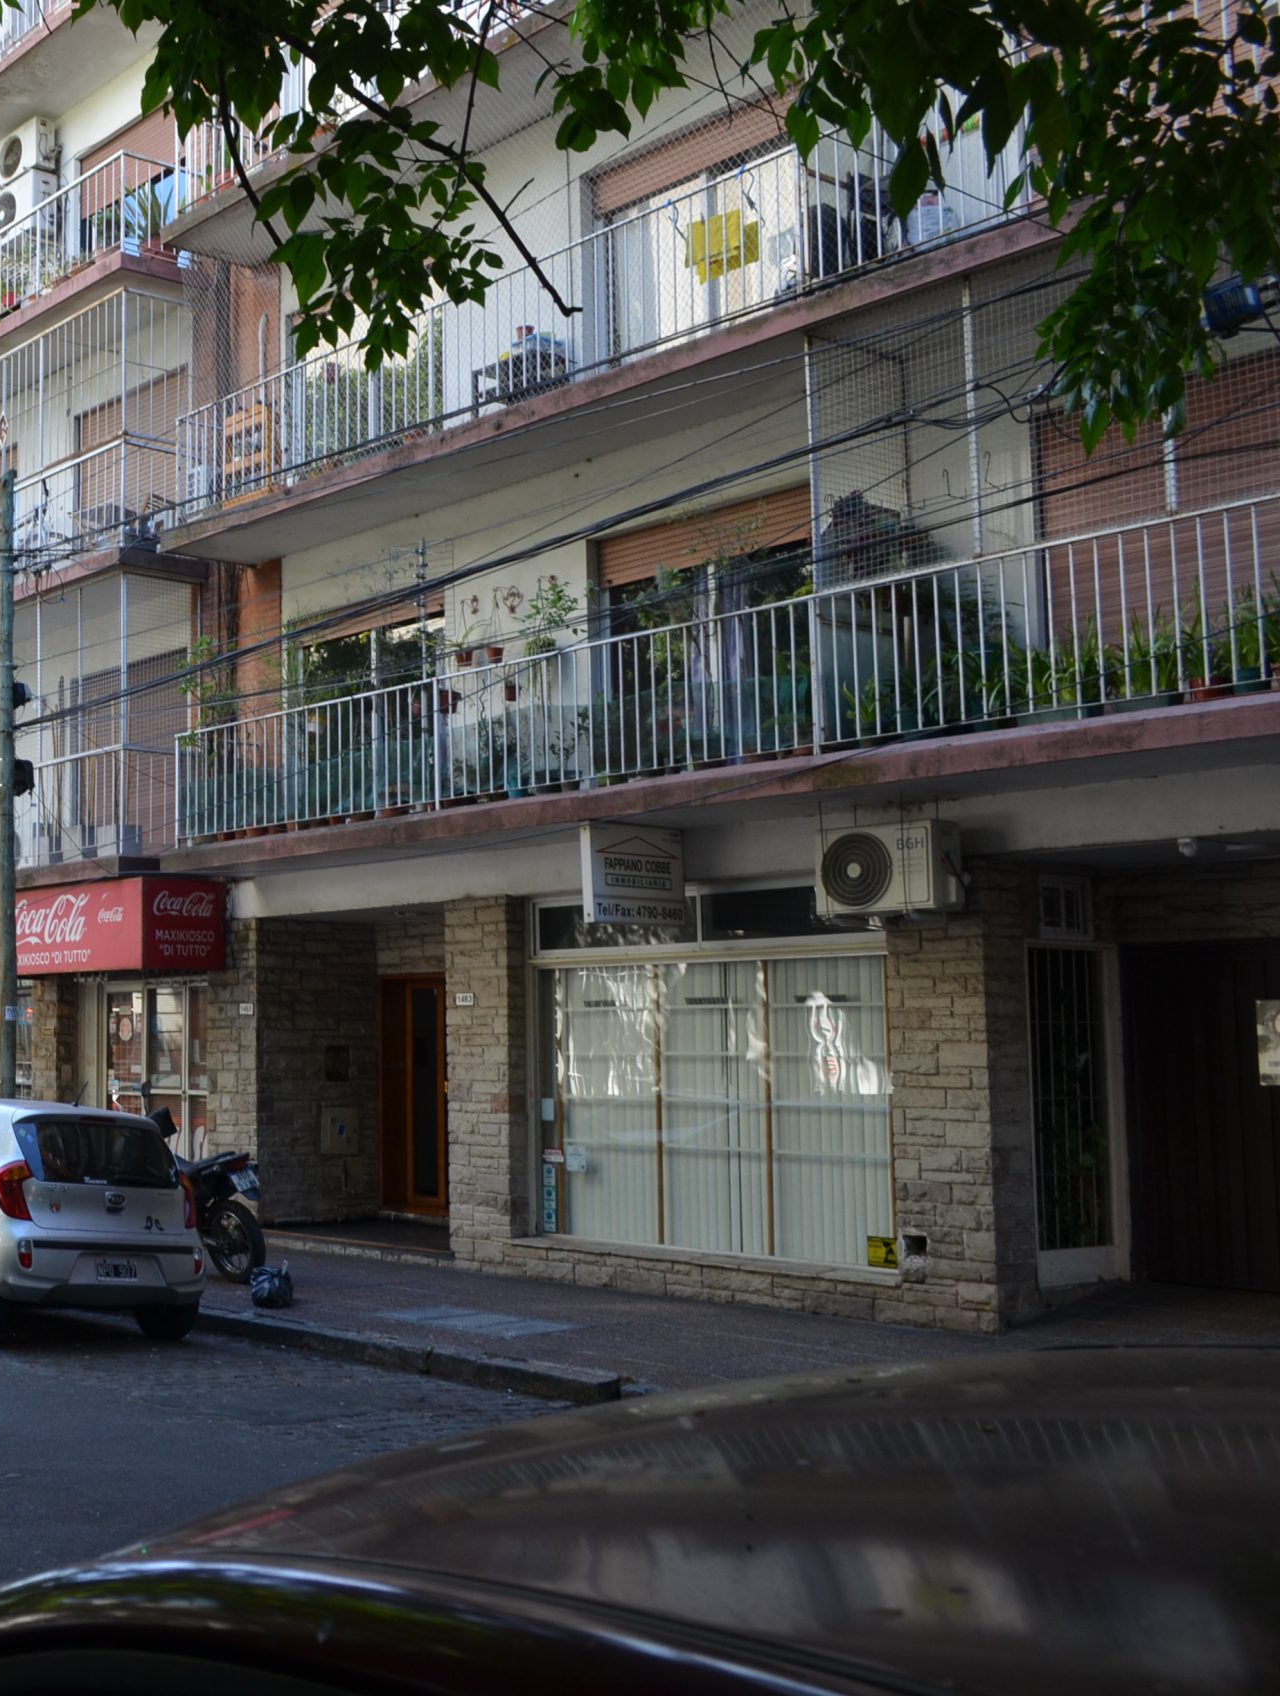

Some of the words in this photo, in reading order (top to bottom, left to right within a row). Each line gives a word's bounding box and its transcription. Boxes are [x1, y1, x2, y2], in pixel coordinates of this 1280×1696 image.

[896, 837, 925, 850] BGH
[604, 857, 643, 873] FAPPIANO
[645, 860, 672, 875] COBBE
[611, 876, 666, 888] INMOBILIARIA
[153, 890, 216, 918] Coca-Cola
[597, 902, 635, 918] Tel/Fax:
[636, 905, 684, 921] 4790-8460
[155, 928, 216, 943] MAXIKIOSCO
[16, 951, 51, 967] XIKIOSCO
[51, 950, 63, 965] "DI
[64, 948, 92, 964] TUTTO"
[159, 944, 174, 957] "DI
[176, 944, 212, 957] TUTTO"
